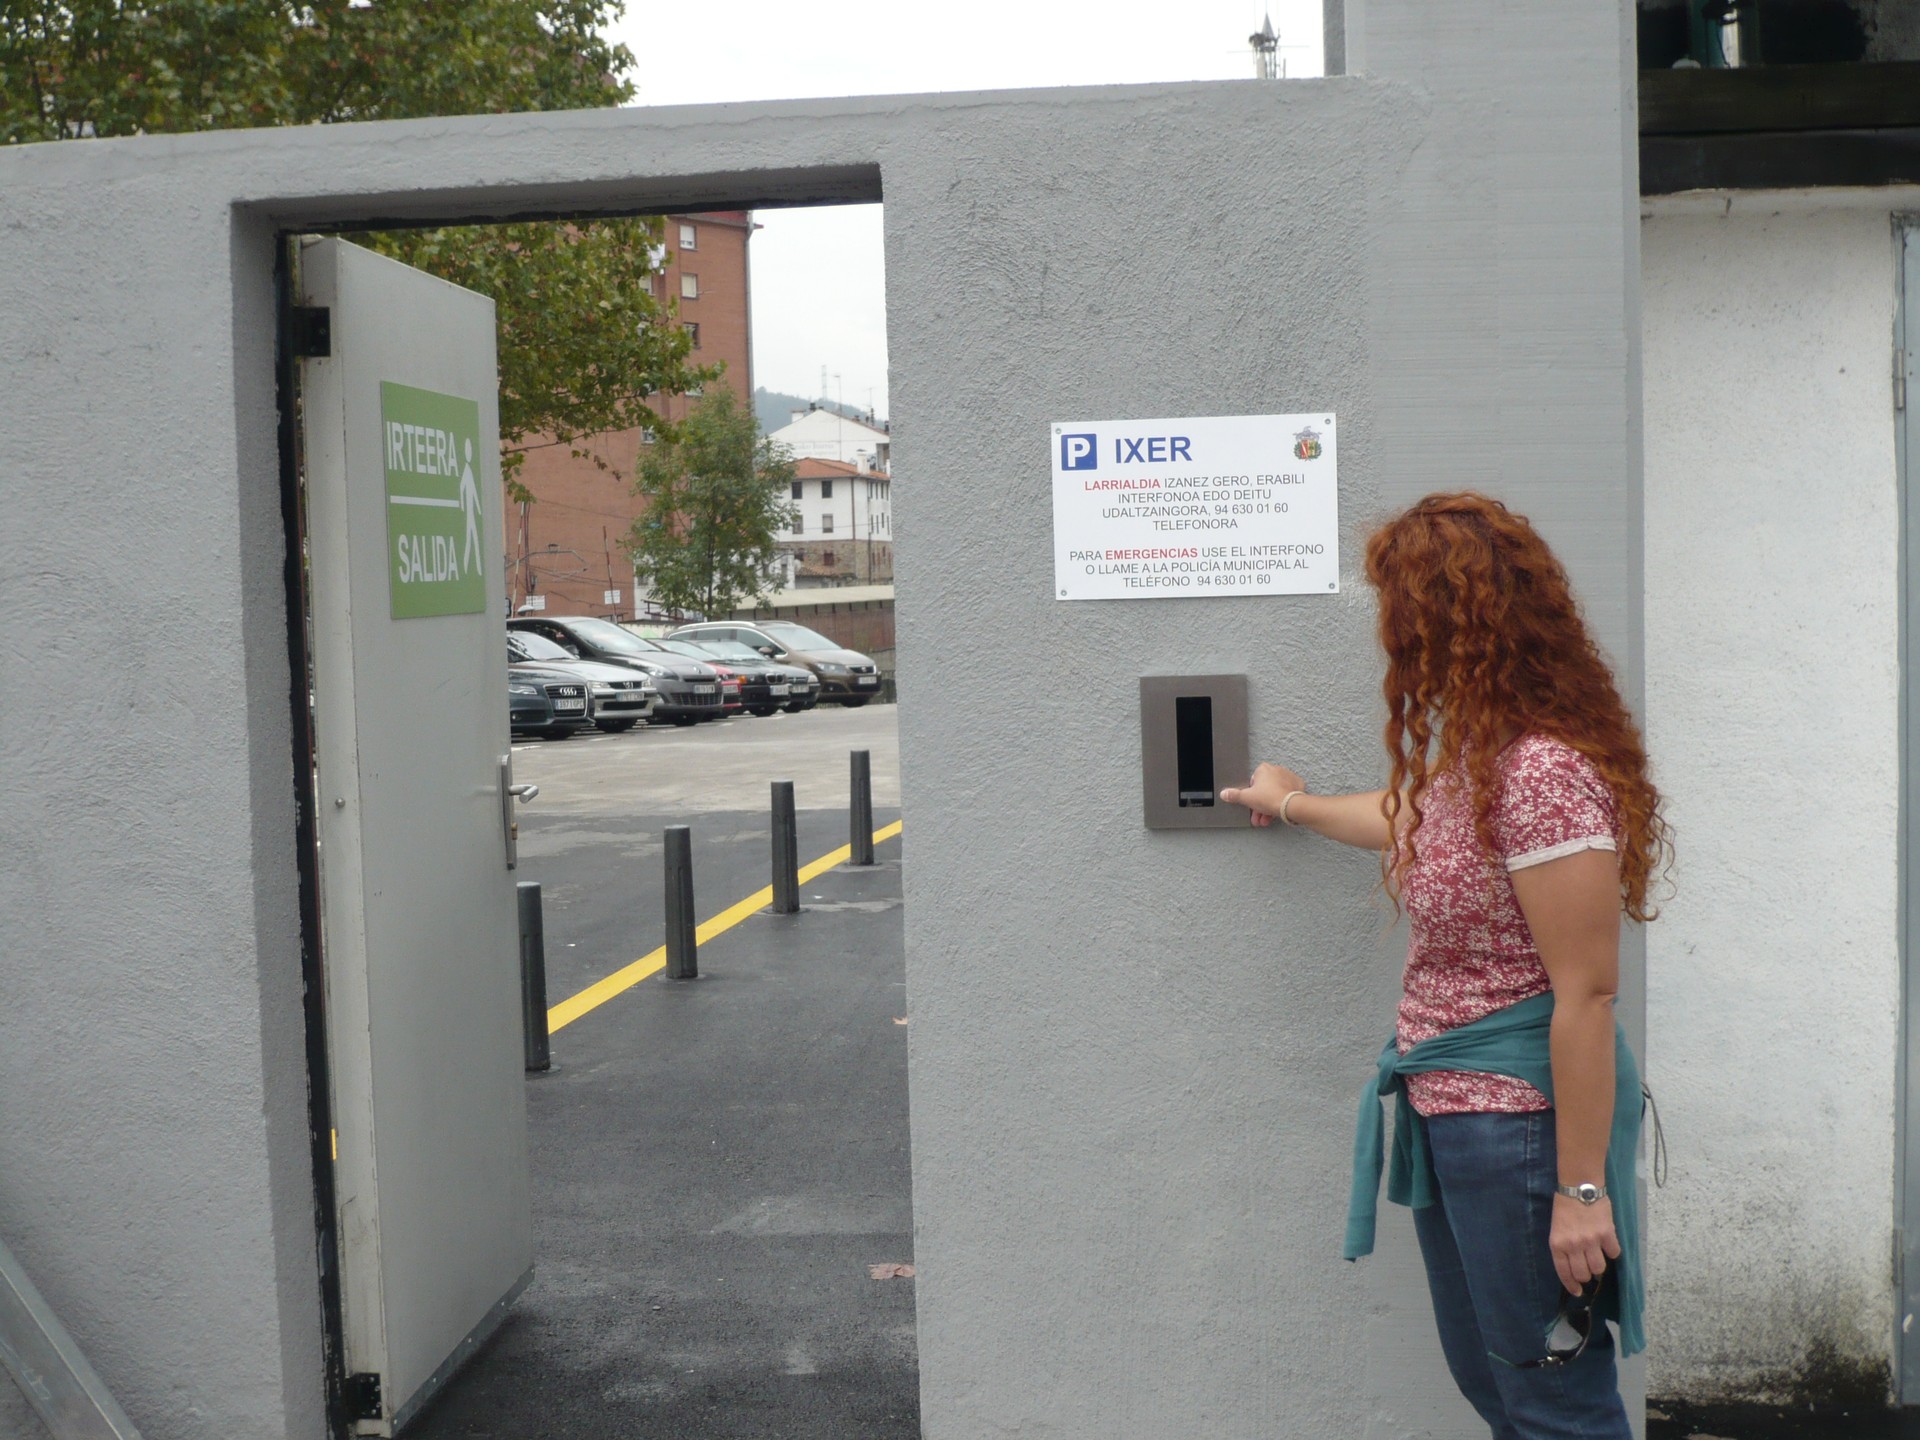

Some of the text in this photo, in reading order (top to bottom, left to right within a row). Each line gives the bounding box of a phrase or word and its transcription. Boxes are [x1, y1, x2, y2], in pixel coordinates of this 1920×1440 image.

[386, 421, 460, 477] IRTEERA
[1115, 436, 1193, 464] IXER
[1084, 473, 1305, 491] LARRIALDIA IZANEZ GERO, ERABILI
[1118, 489, 1272, 504] INTERFONOA EDO DEITU
[1102, 502, 1289, 519] UDALTZAINGORA, 94 630 01 60
[1153, 518, 1239, 531] TELEFONORA
[398, 533, 460, 584] SALIDA
[1069, 544, 1325, 561] PARA EMERGENCIAS USE EL INTERFONO
[1085, 558, 1310, 575] O LLAME A LA POLICÍA MUNICIPAL AL
[1123, 573, 1271, 588] TELÉFONO 94 630 01 60
